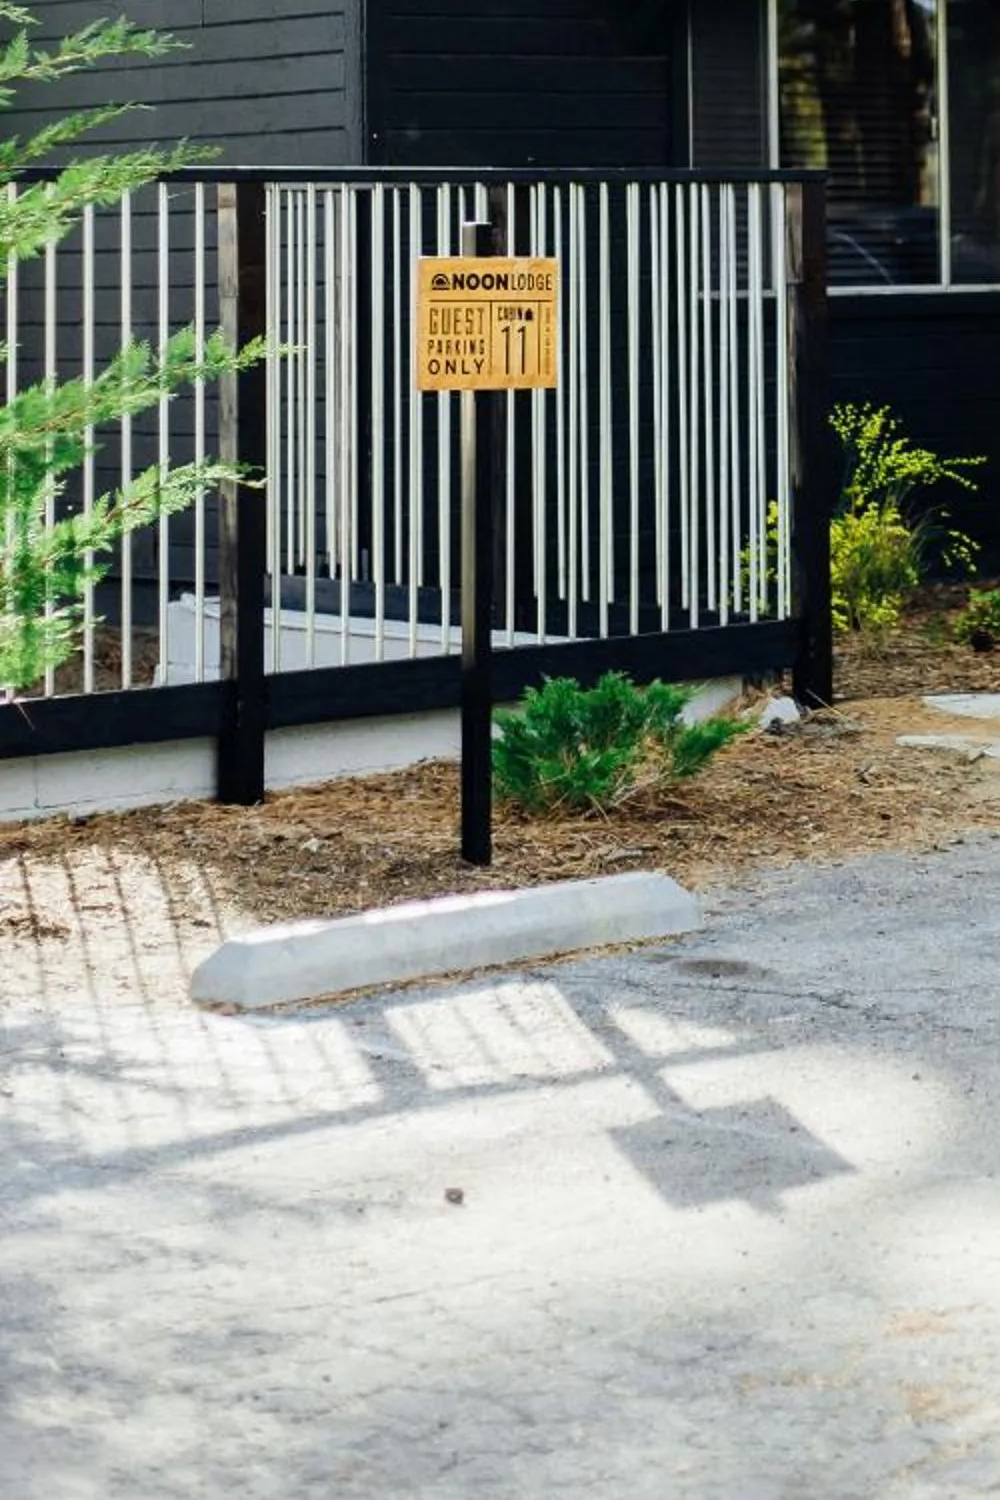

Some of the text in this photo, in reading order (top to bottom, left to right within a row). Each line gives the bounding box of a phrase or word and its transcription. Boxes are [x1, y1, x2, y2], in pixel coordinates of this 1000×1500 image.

[429, 307, 485, 335] GUEST
[428, 339, 485, 355] PARKING
[501, 325, 526, 375] 11
[428, 359, 485, 375] ONLY
